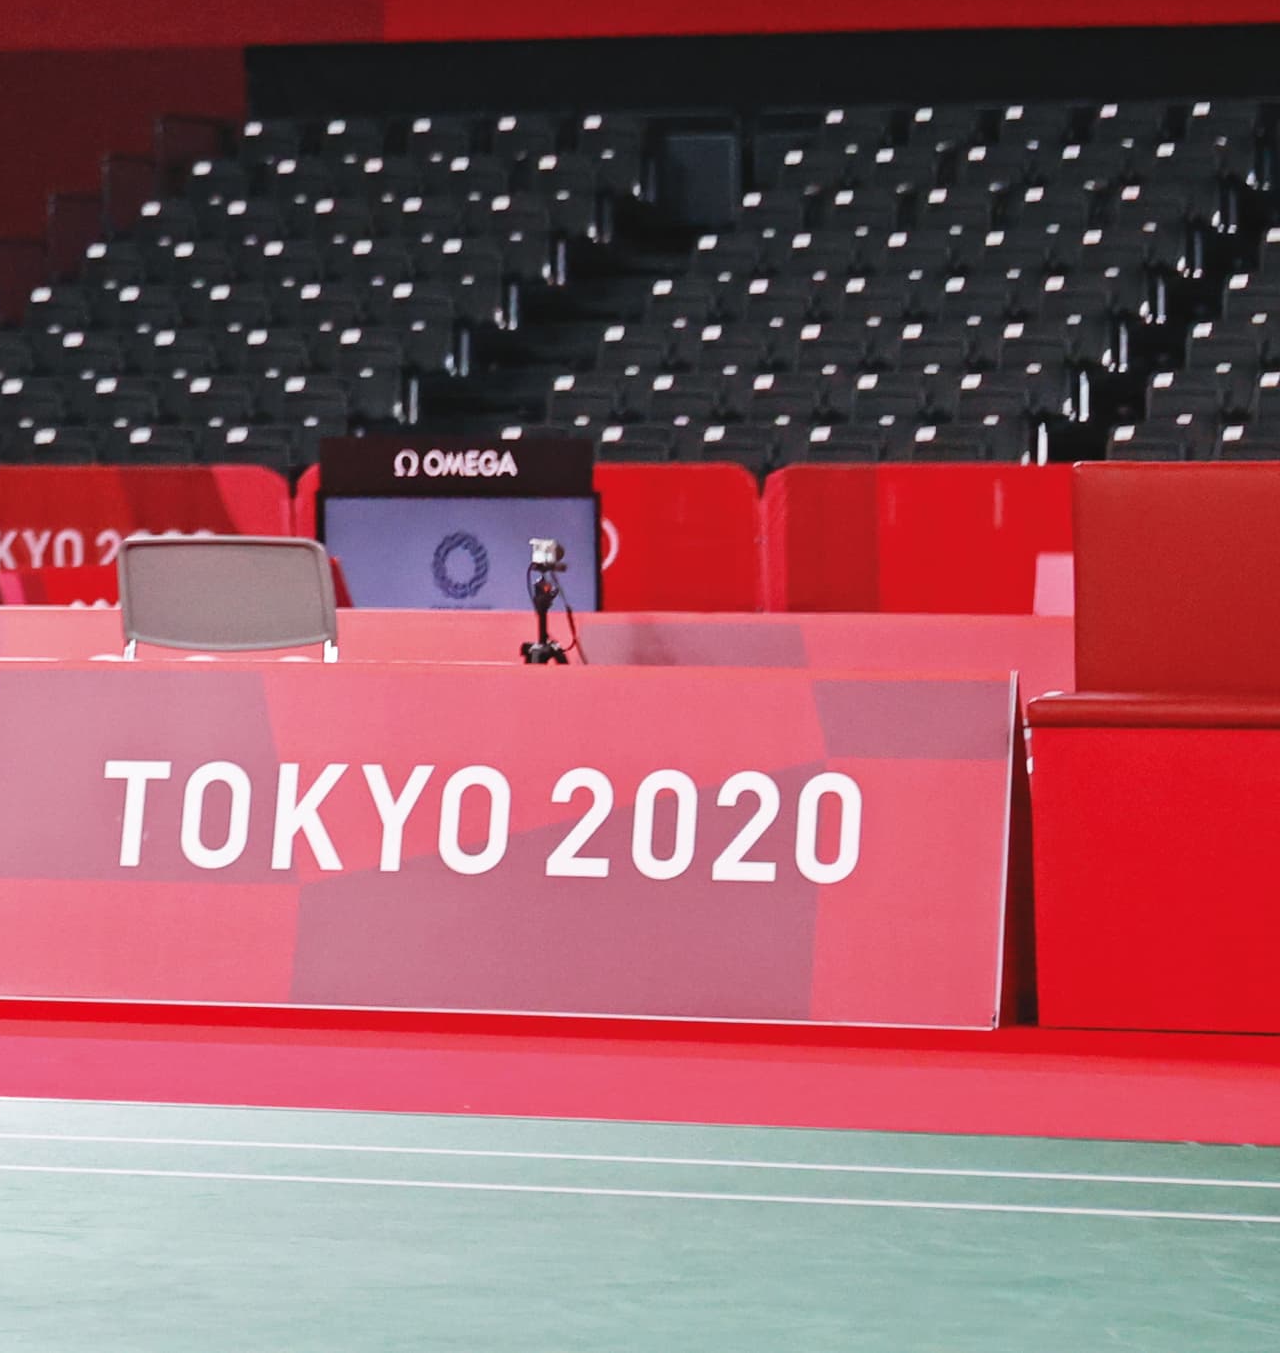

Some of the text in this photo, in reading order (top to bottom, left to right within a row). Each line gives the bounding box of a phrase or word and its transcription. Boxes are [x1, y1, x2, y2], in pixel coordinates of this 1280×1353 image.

[422, 449, 518, 477] OMEGA
[104, 760, 863, 885] TOKYO 2020
